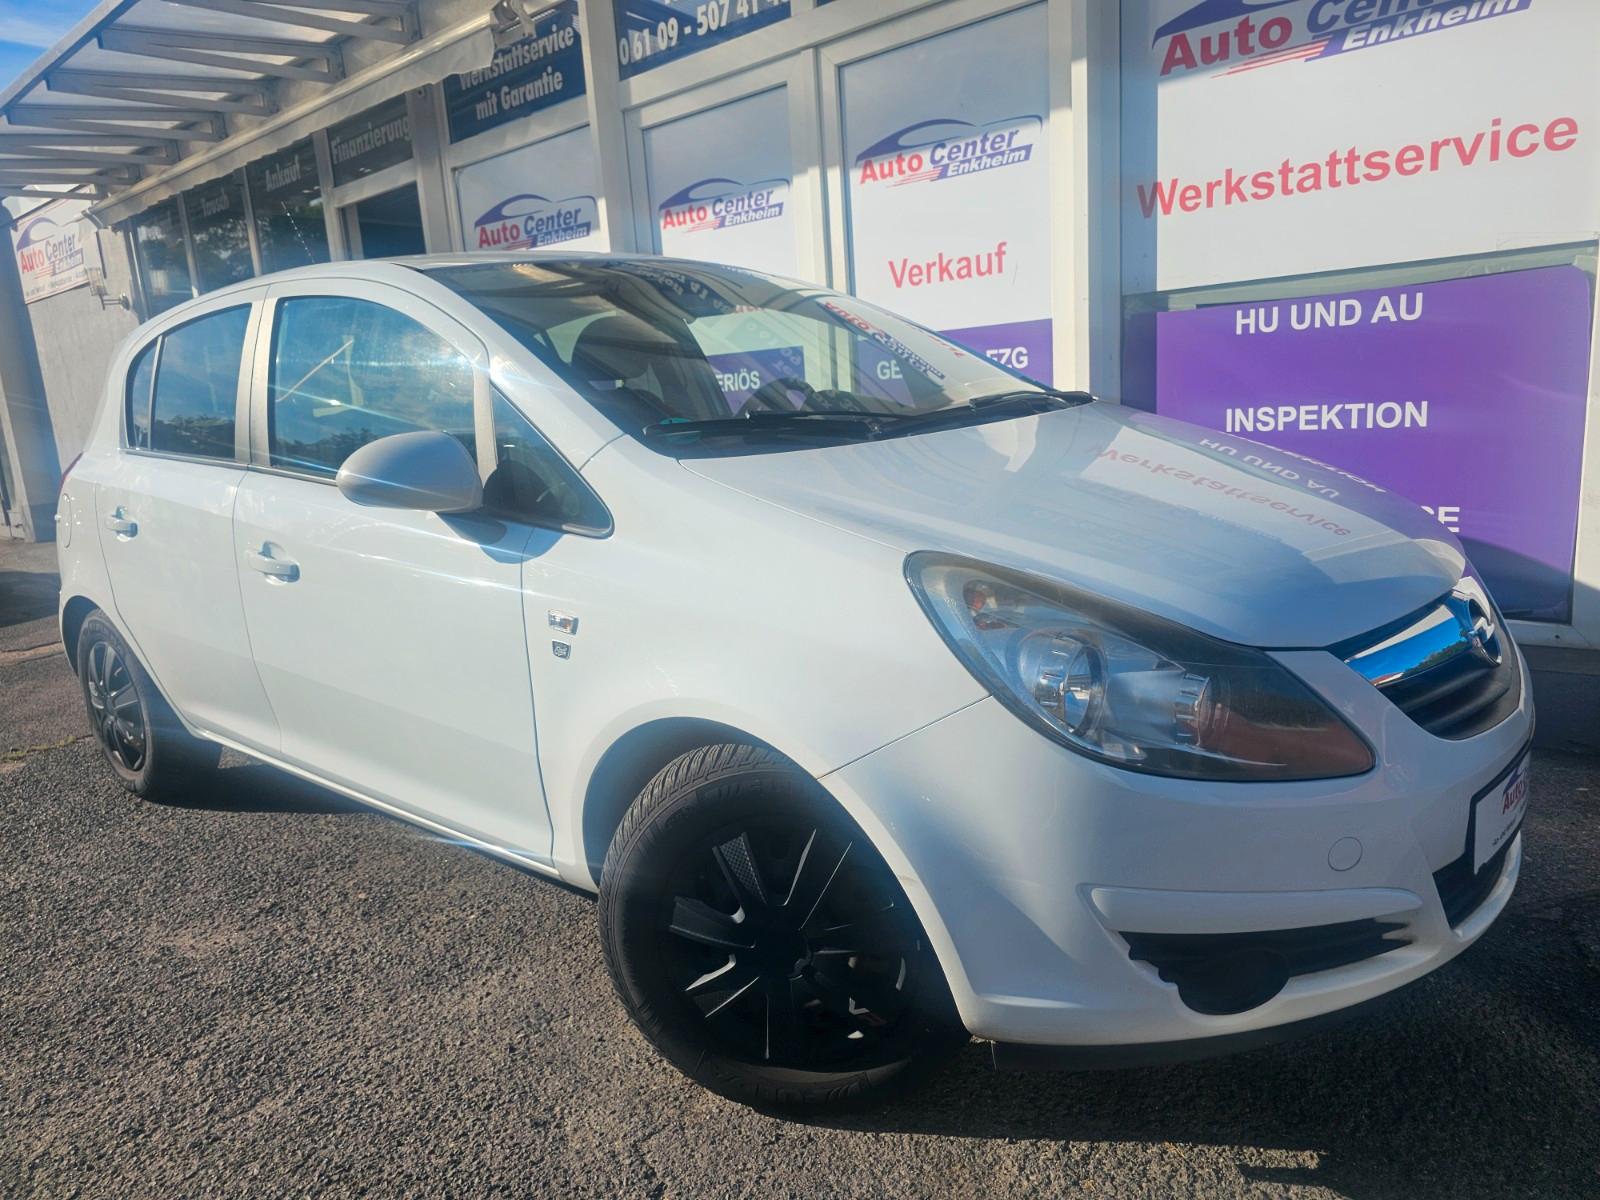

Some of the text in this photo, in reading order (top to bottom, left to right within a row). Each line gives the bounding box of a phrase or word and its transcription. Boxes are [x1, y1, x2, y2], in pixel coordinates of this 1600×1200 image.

[1159, 15, 1293, 77] Auto
[475, 66, 563, 121] mit Garantie
[331, 115, 411, 164] Finanzierung
[860, 129, 1019, 184] Auto Center
[265, 155, 301, 192] Ankauf
[947, 148, 1026, 176] Enkheim
[1137, 116, 1579, 219] Werkstattservice
[479, 207, 581, 249] Auto Center
[663, 189, 774, 230] Auto Center
[725, 207, 779, 226] Enkheim
[20, 248, 45, 275] Auto
[45, 233, 76, 263] Center
[537, 227, 588, 246] Enkheim
[888, 241, 1007, 289] Verkauf
[1235, 292, 1423, 336] HU UND AU
[1225, 400, 1428, 433] INSPEKTION
